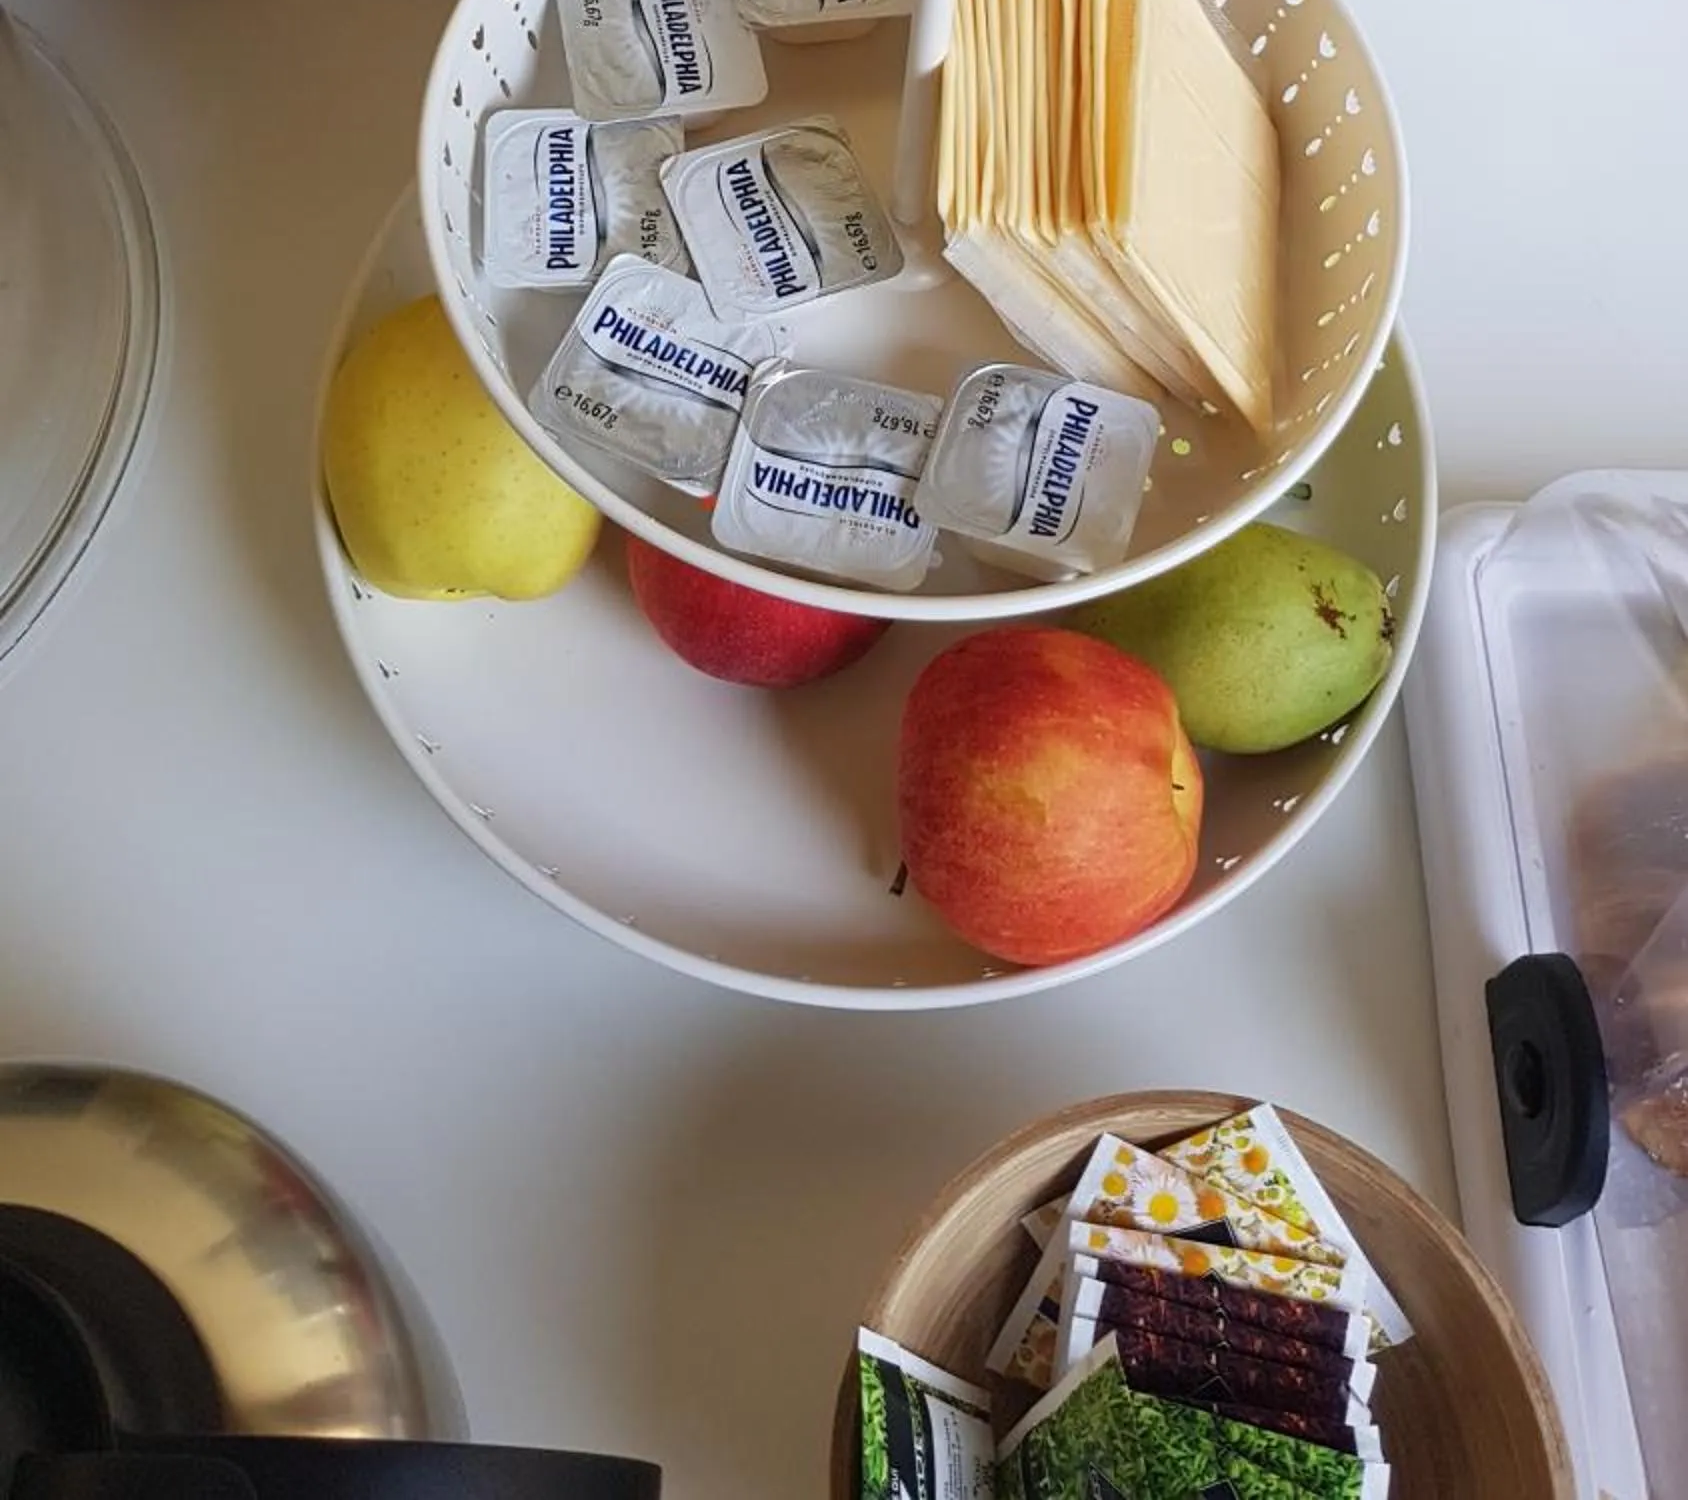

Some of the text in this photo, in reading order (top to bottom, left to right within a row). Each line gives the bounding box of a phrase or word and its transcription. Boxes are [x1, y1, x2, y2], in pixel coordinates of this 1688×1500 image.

[547, 128, 578, 270] PHILADELPHIA
[726, 158, 806, 298] PHILADELPHIA
[593, 306, 751, 397] PHILADELPHIA
[574, 393, 618, 430] 16,67g
[873, 406, 921, 438] 16,67g
[754, 461, 920, 531] PHILADELPHIA
[1029, 397, 1098, 537] PHILADELPHIA
